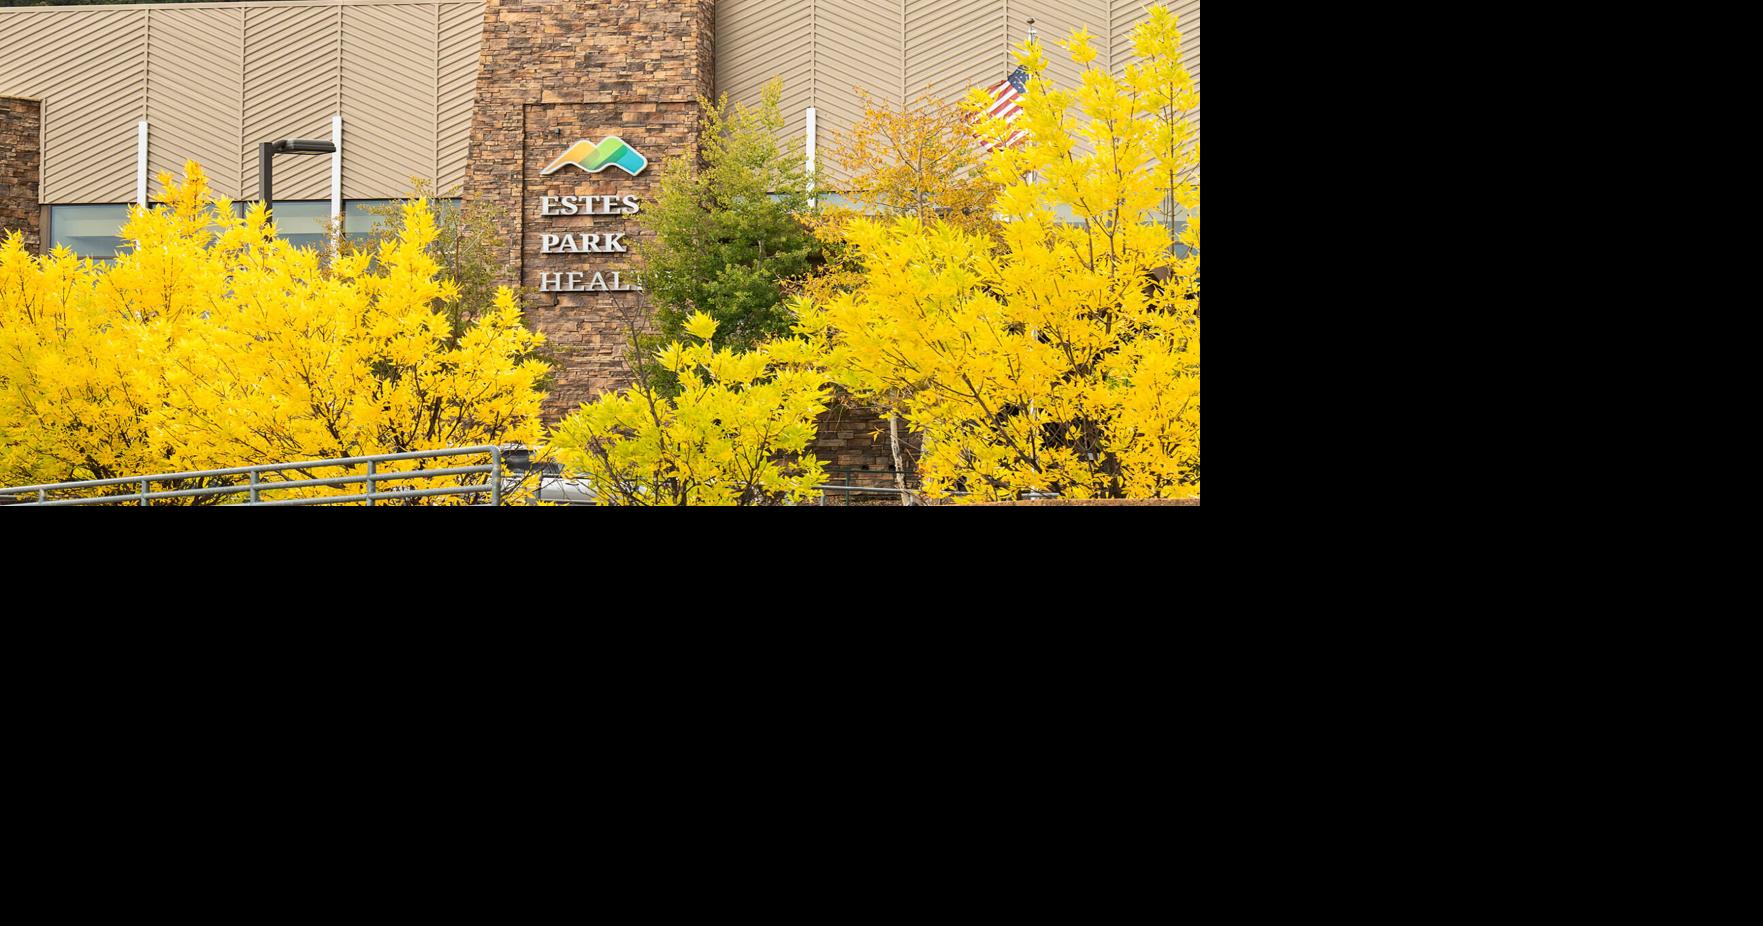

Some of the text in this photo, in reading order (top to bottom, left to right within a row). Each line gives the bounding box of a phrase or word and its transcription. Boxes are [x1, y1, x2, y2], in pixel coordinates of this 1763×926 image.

[540, 194, 640, 216] ESTES
[540, 232, 627, 253] PARK
[539, 271, 674, 292] HEAL
